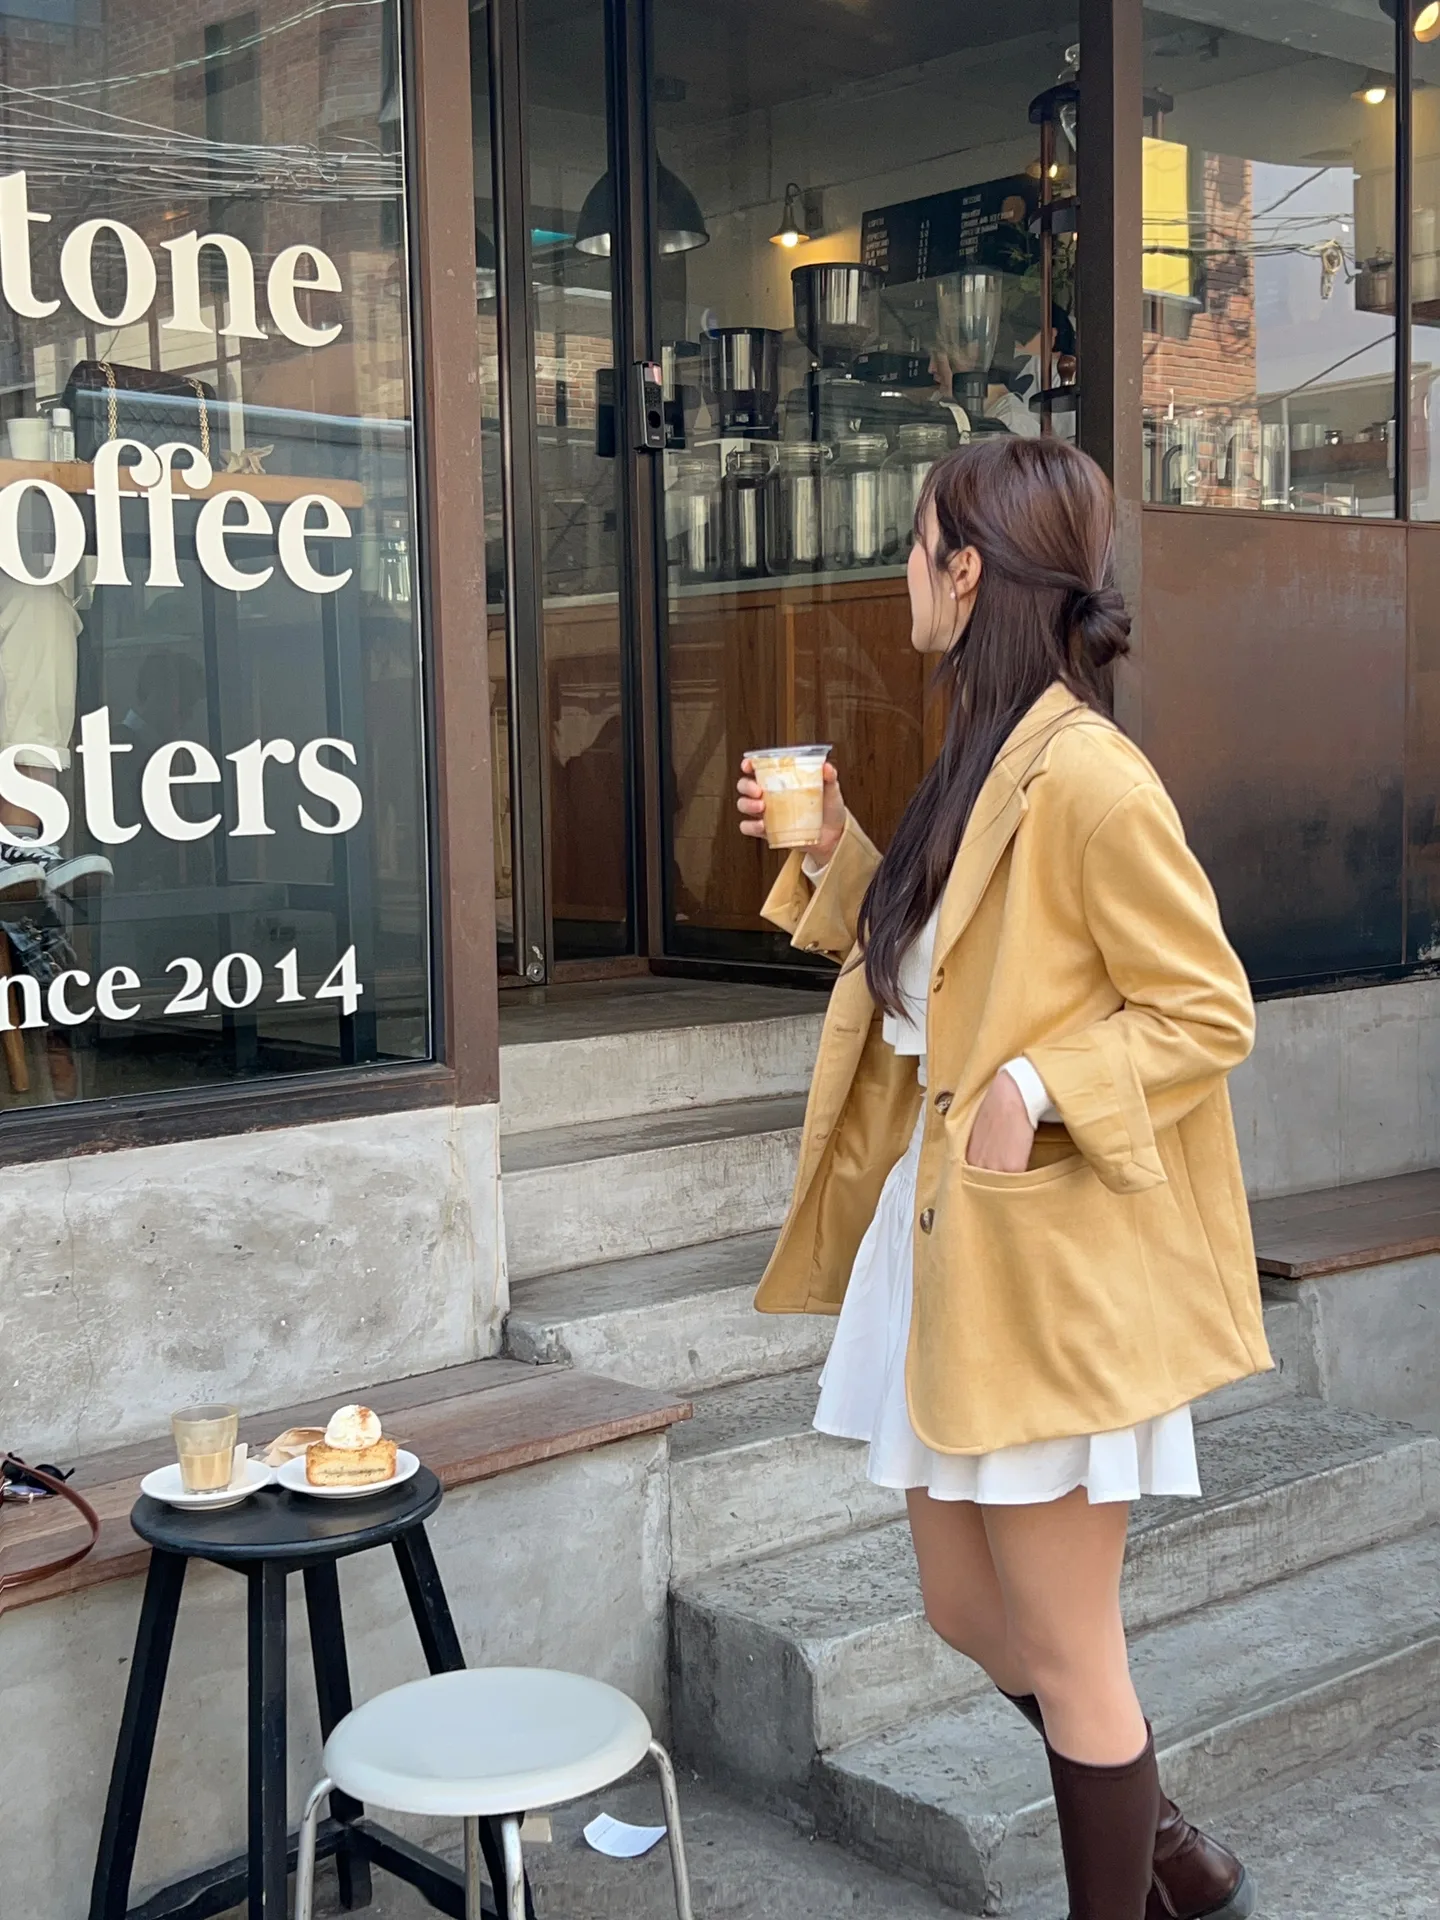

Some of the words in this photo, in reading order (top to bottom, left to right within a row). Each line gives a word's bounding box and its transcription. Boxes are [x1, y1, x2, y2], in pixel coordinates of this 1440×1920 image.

[0, 170, 343, 347] tone
[0, 438, 353, 594] offee
[0, 705, 363, 849] sters
[0, 967, 142, 1032] nce
[163, 944, 364, 1016] 2014
